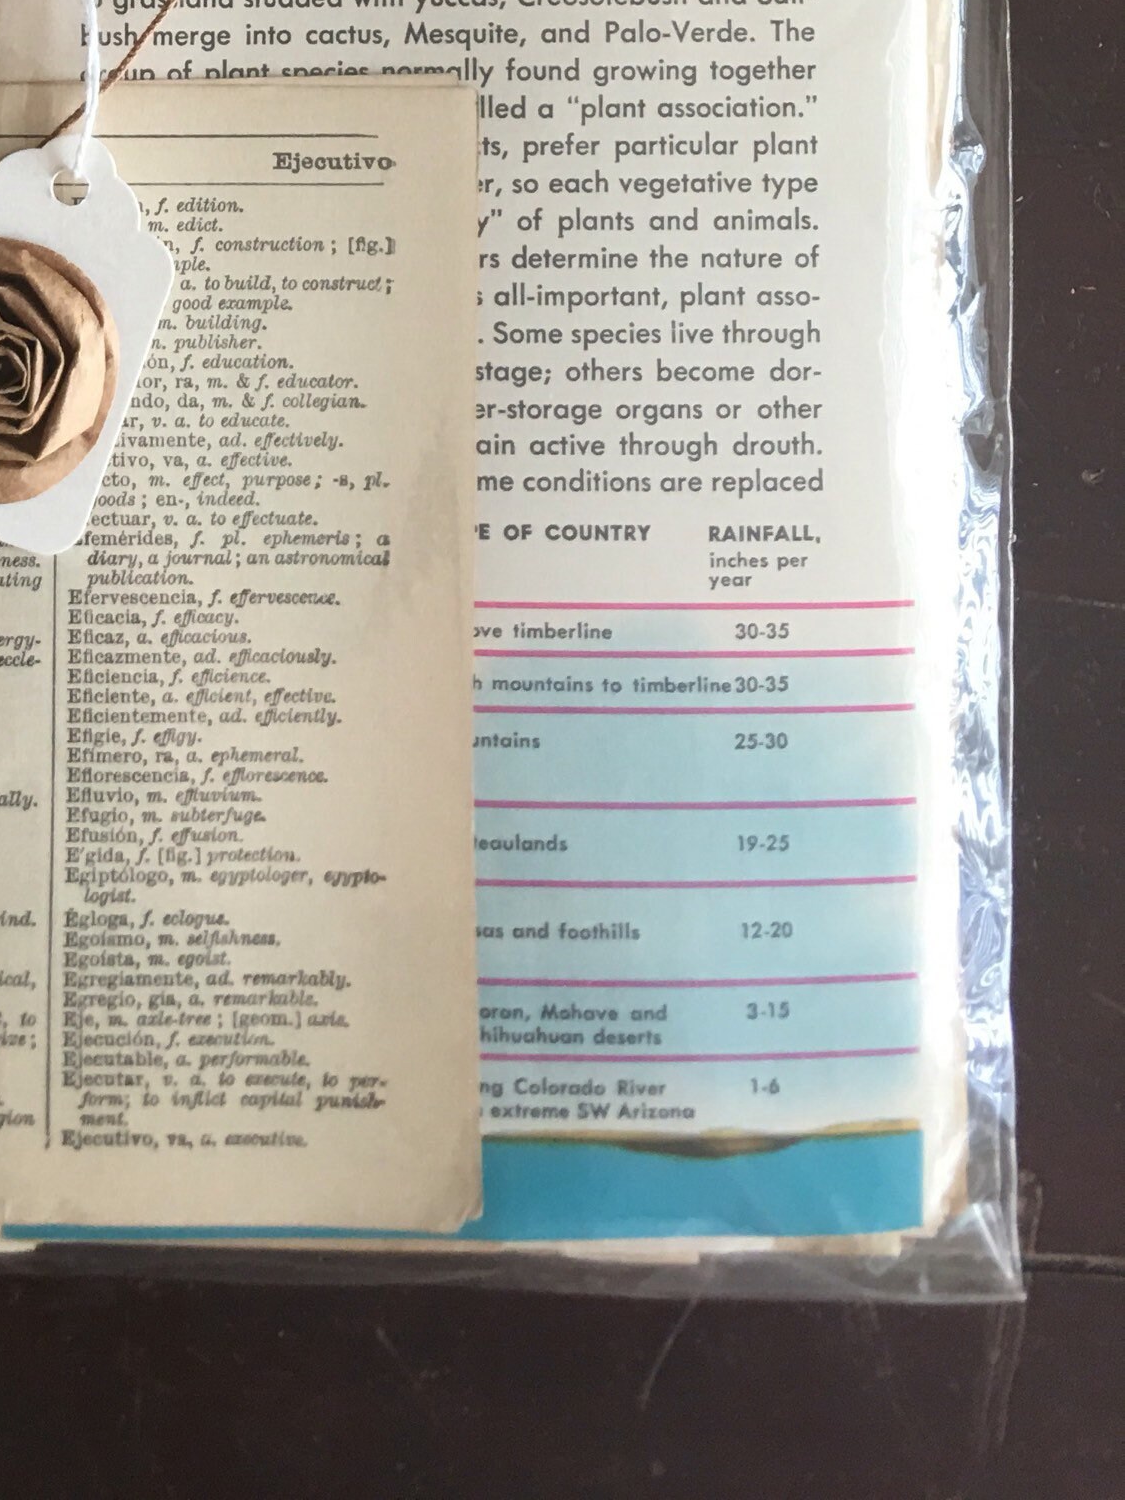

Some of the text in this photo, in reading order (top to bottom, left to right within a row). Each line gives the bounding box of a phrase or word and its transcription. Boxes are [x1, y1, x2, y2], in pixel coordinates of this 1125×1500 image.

[245, 18, 816, 51] into cactus, Mesquite, and Palo-Verde. The
[271, 151, 393, 174] Ejecutivo
[516, 206, 819, 239] of plants and animals.
[503, 523, 651, 542] OF COUNTRY
[708, 524, 821, 543] RAINFALL,
[709, 551, 809, 572] inches per
[708, 575, 753, 591] year
[67, 587, 341, 612] Efervescencia, f. effervescence.
[66, 624, 252, 651] Eficaz, a. efficacious.
[512, 621, 613, 640] timberline
[734, 622, 790, 640] 30-35
[66, 665, 271, 691] Eficiencia, f. efficience.
[491, 675, 732, 694] mountains to timberline
[734, 675, 789, 694] 30-35
[734, 732, 789, 750] 25-30
[737, 833, 790, 853] 19-25
[511, 921, 641, 941] and foothills
[741, 920, 794, 939] 12-20
[539, 1003, 668, 1022] Mohave and
[746, 1000, 791, 1021] 3-15
[592, 1027, 663, 1046] deserts
[512, 1076, 667, 1097] Colorado River
[750, 1077, 781, 1096] 1-6
[489, 1101, 696, 1120] extreme SW Arizona
